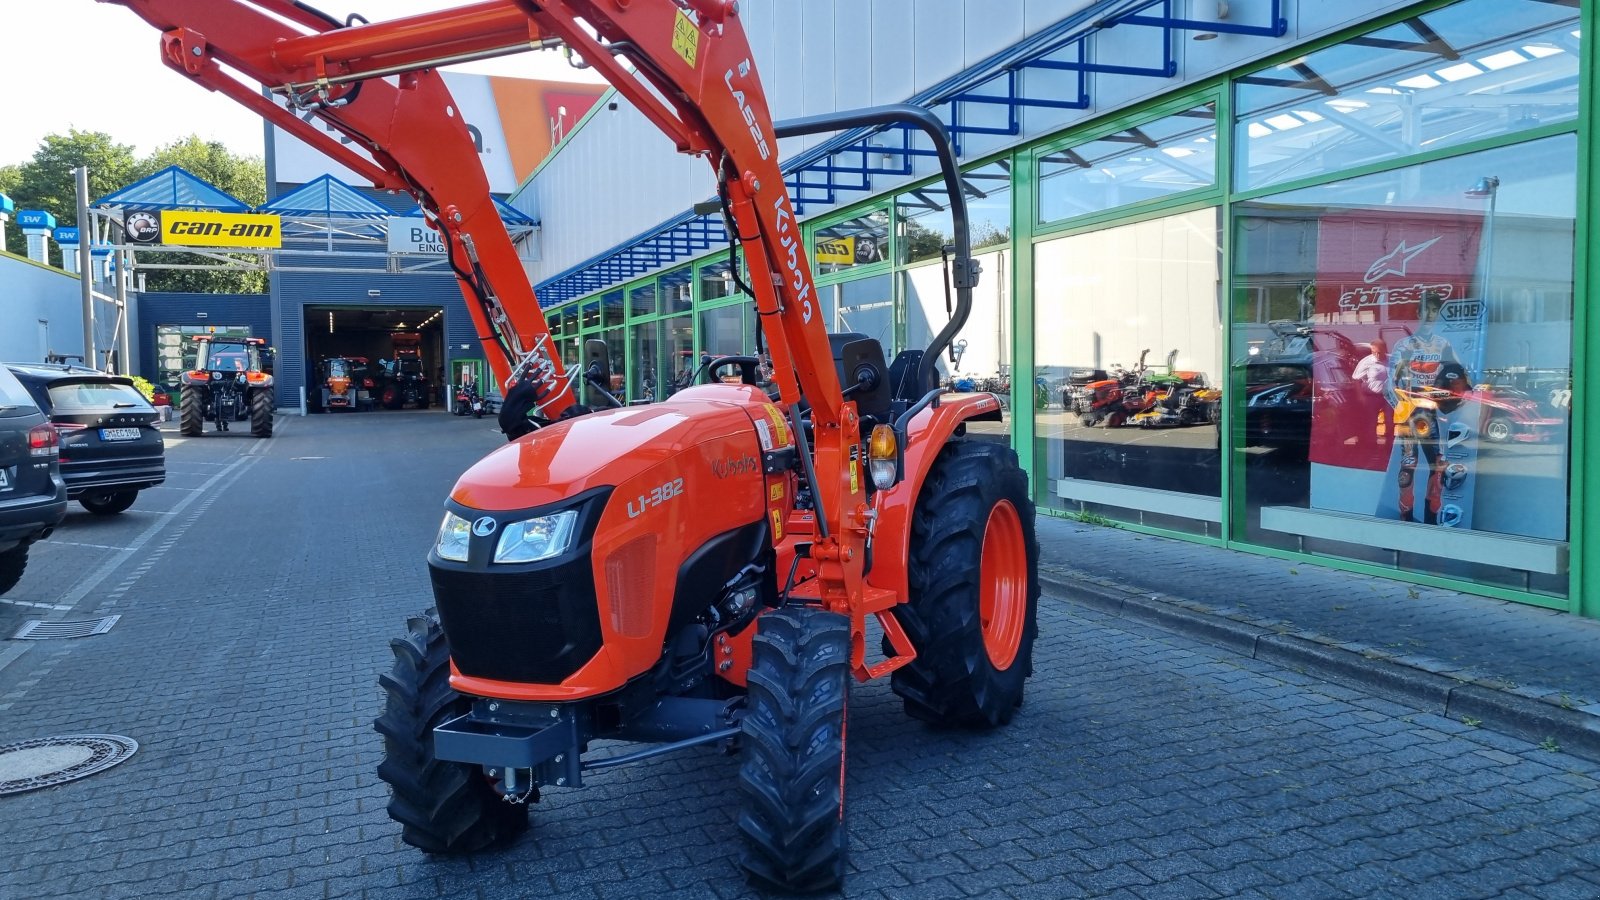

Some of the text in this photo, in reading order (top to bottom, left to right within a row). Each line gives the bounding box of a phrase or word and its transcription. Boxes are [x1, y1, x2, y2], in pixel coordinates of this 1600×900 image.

[725, 69, 770, 160] LA525
[169, 221, 274, 238] can-am
[418, 243, 447, 252] EING
[774, 195, 812, 324] Kubota
[712, 453, 759, 479] Kubota
[627, 477, 684, 518] L1-382
